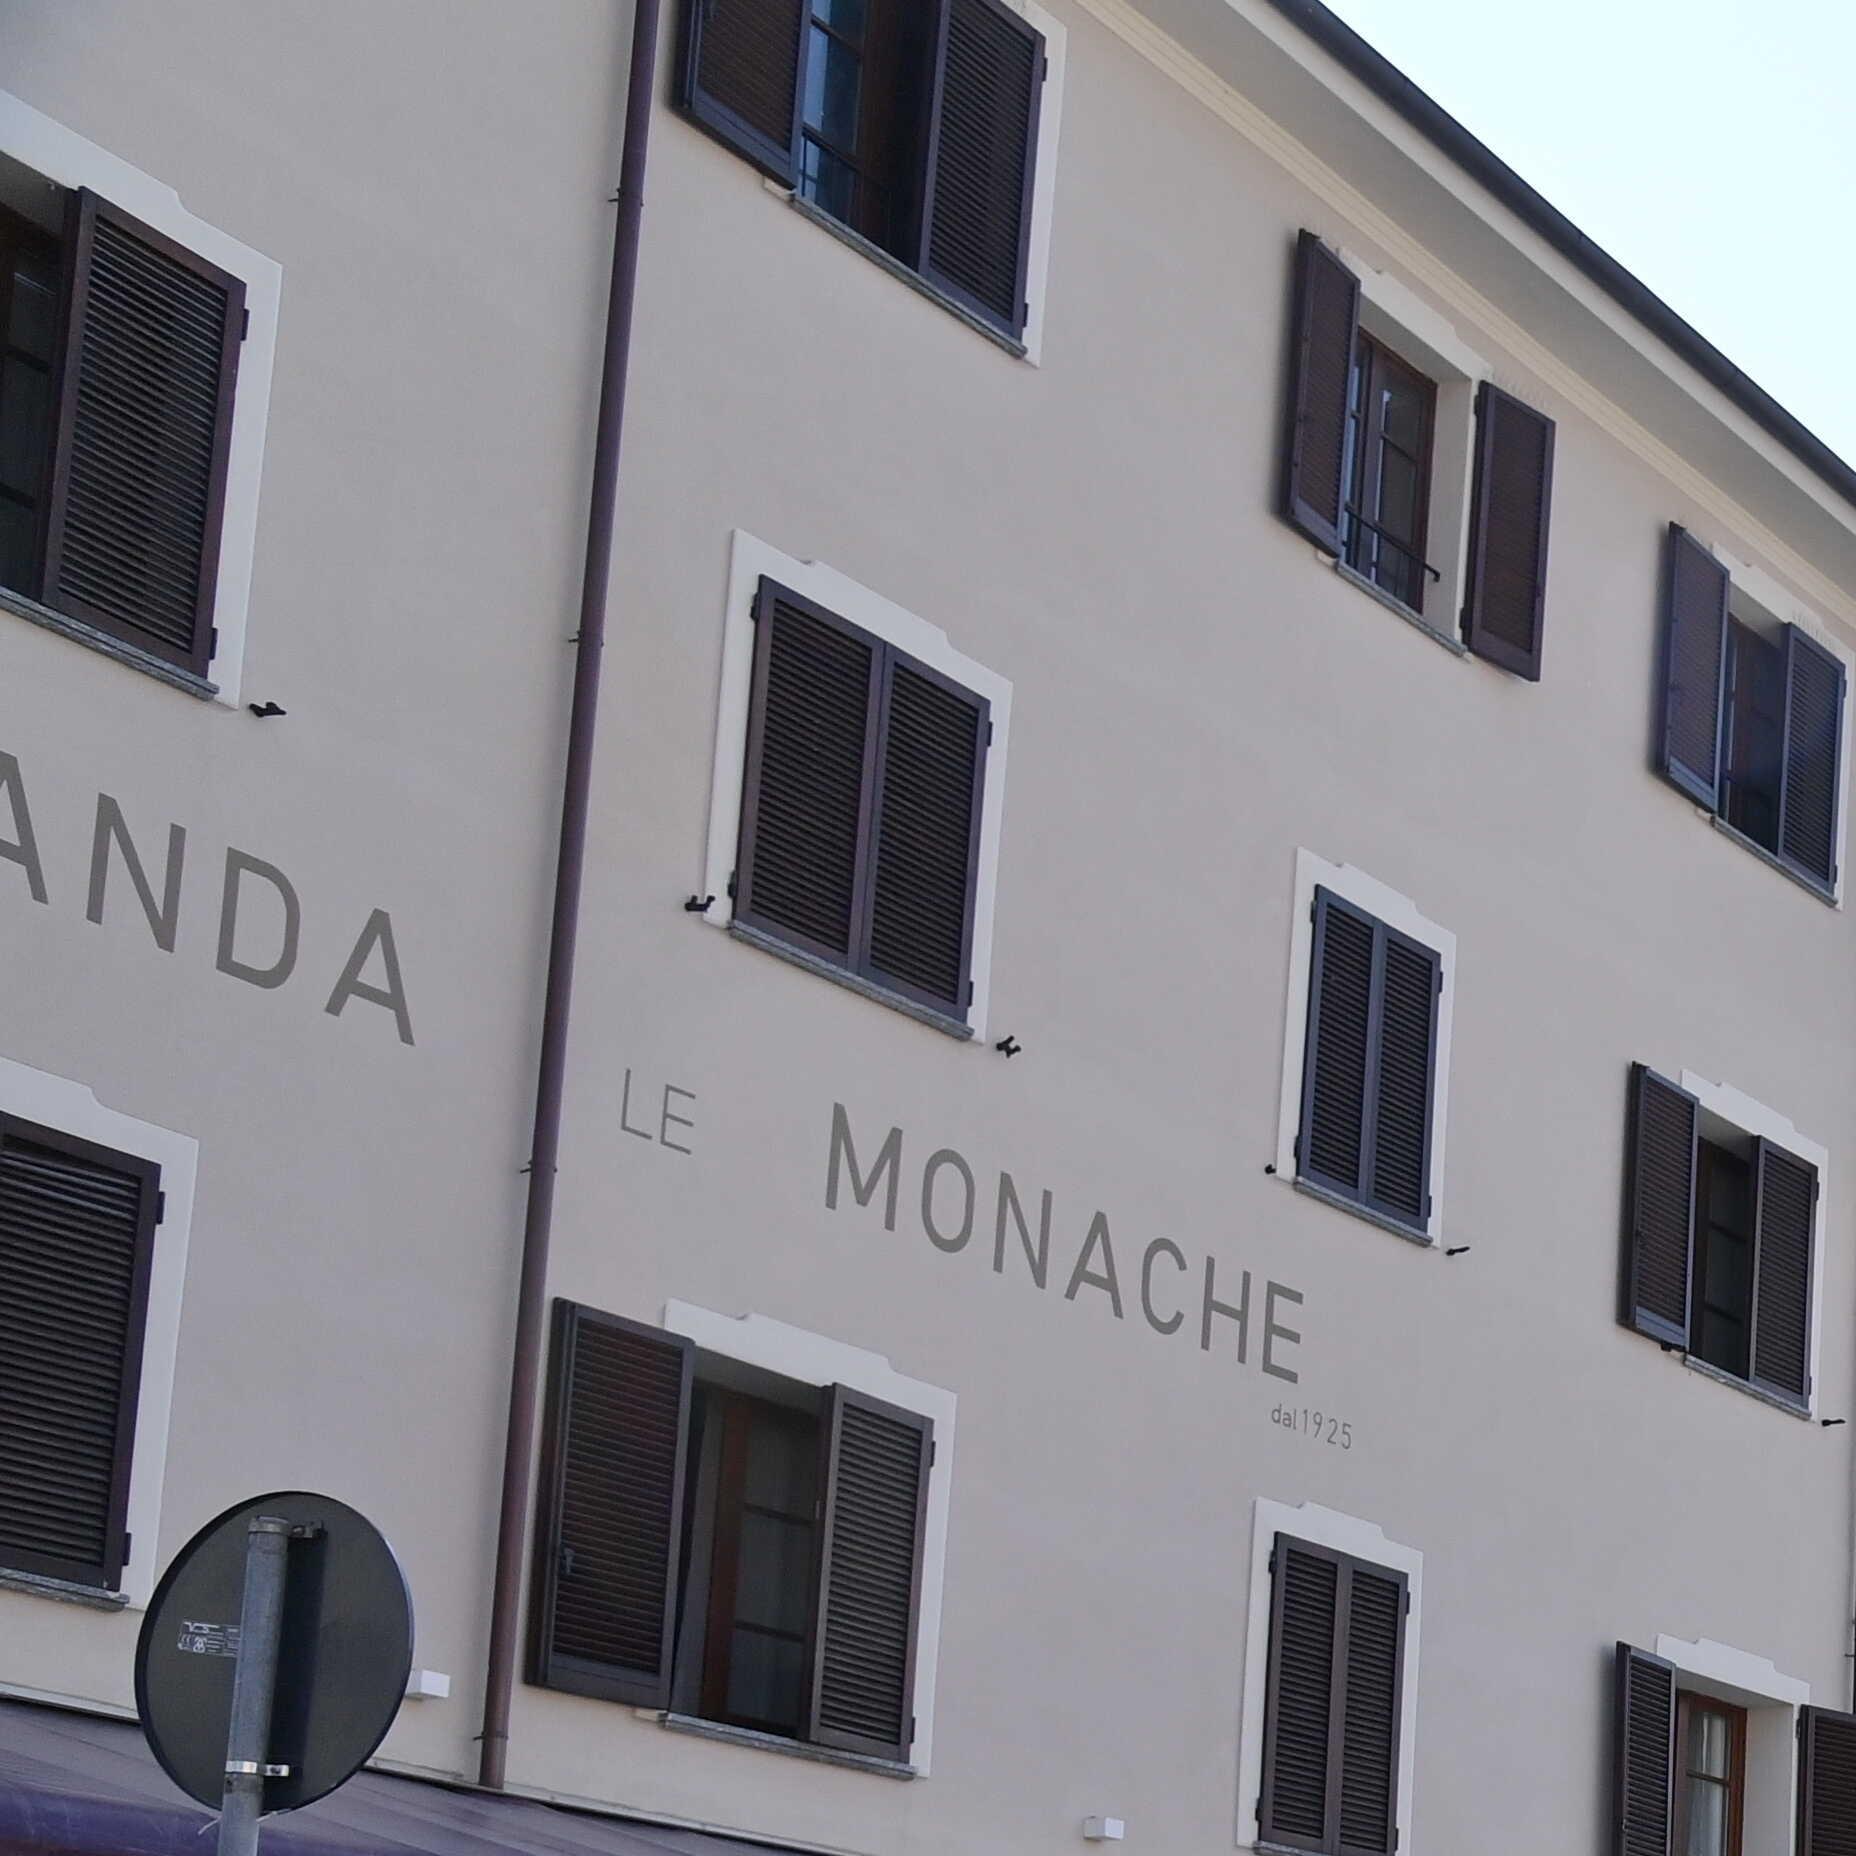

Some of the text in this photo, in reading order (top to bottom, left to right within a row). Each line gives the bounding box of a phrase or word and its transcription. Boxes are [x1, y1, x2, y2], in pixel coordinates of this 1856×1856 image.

[619, 1069, 1305, 1385] LE MONACHE
[1301, 1408, 1353, 1449] 1925
